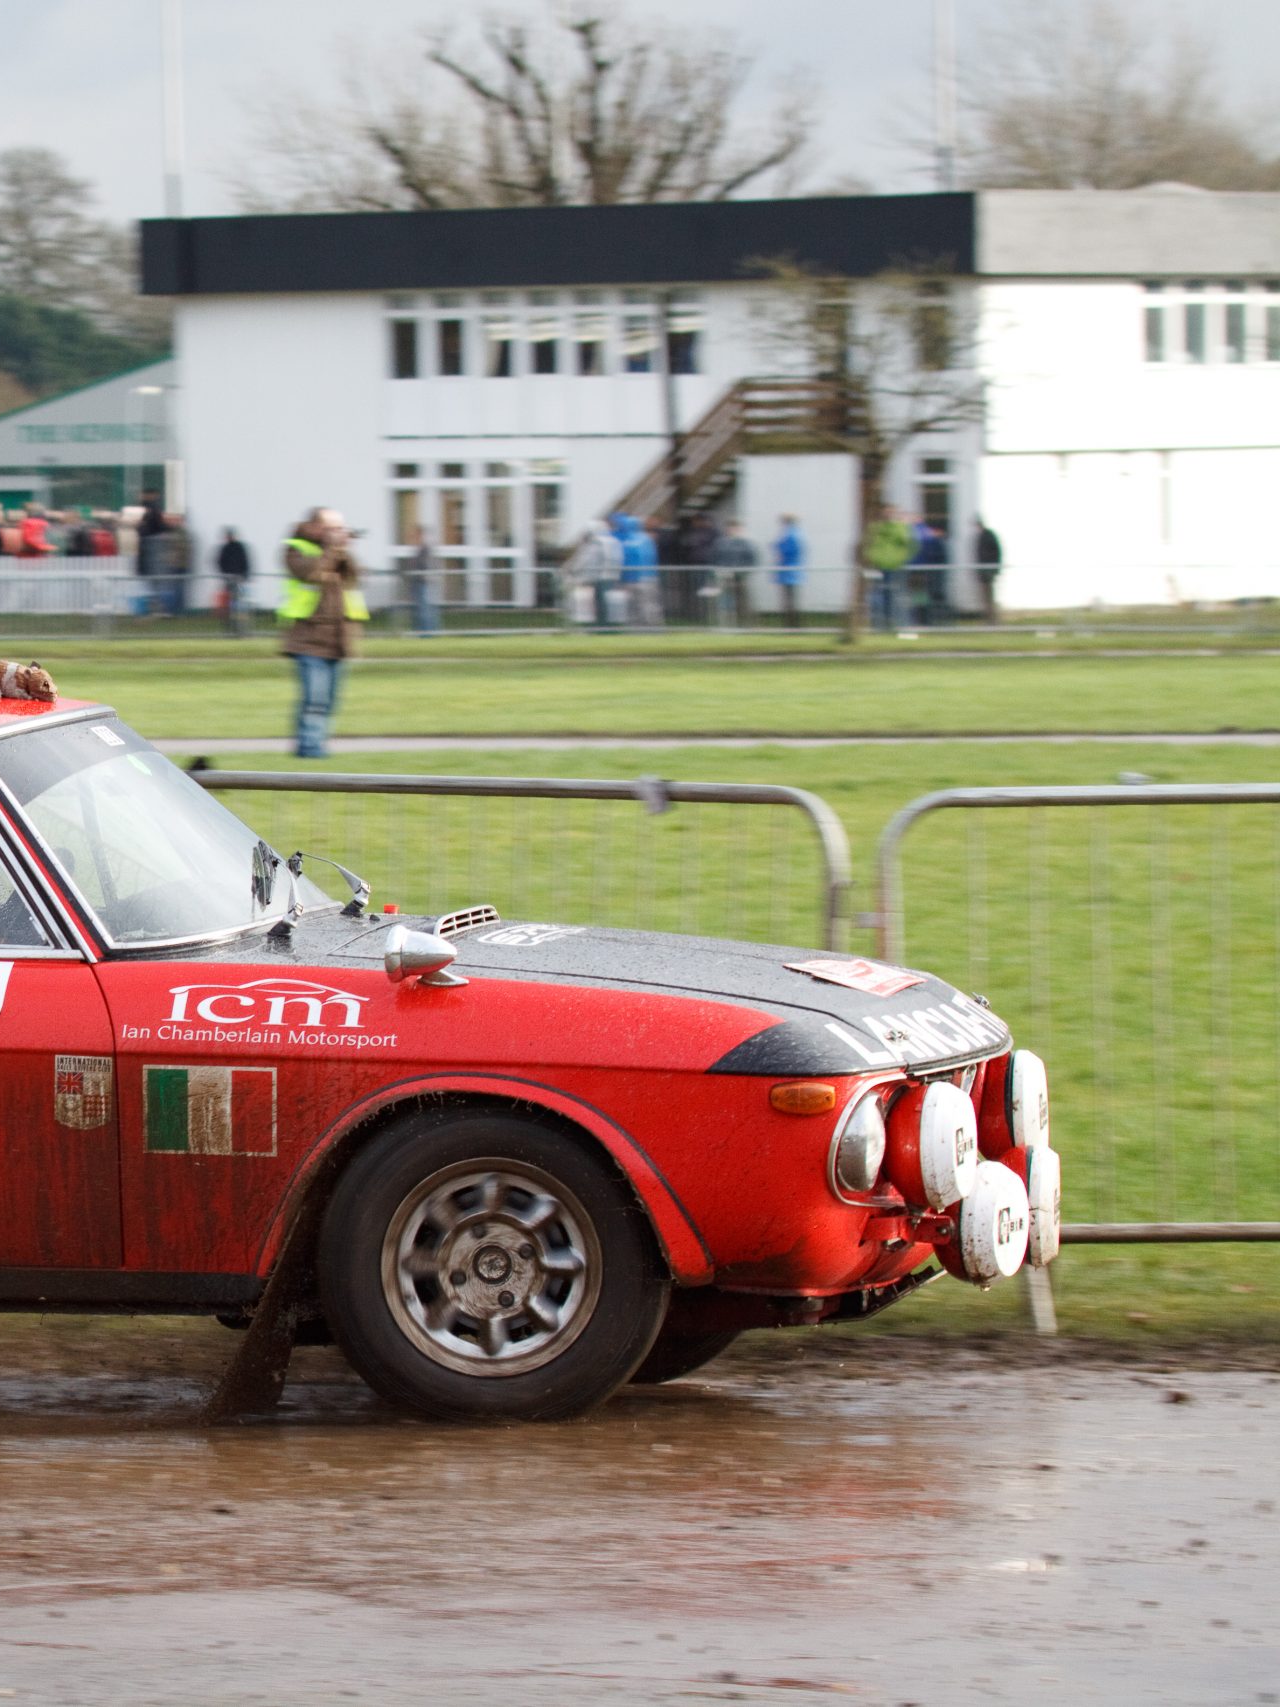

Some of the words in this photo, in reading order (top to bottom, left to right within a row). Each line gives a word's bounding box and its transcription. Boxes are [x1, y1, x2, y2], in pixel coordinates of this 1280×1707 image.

[122, 1024, 151, 1039] Ian
[157, 1025, 281, 1045] Chamberlain
[287, 1030, 398, 1050] Motorsport
[56, 1056, 111, 1066] INTERNATIONAL
